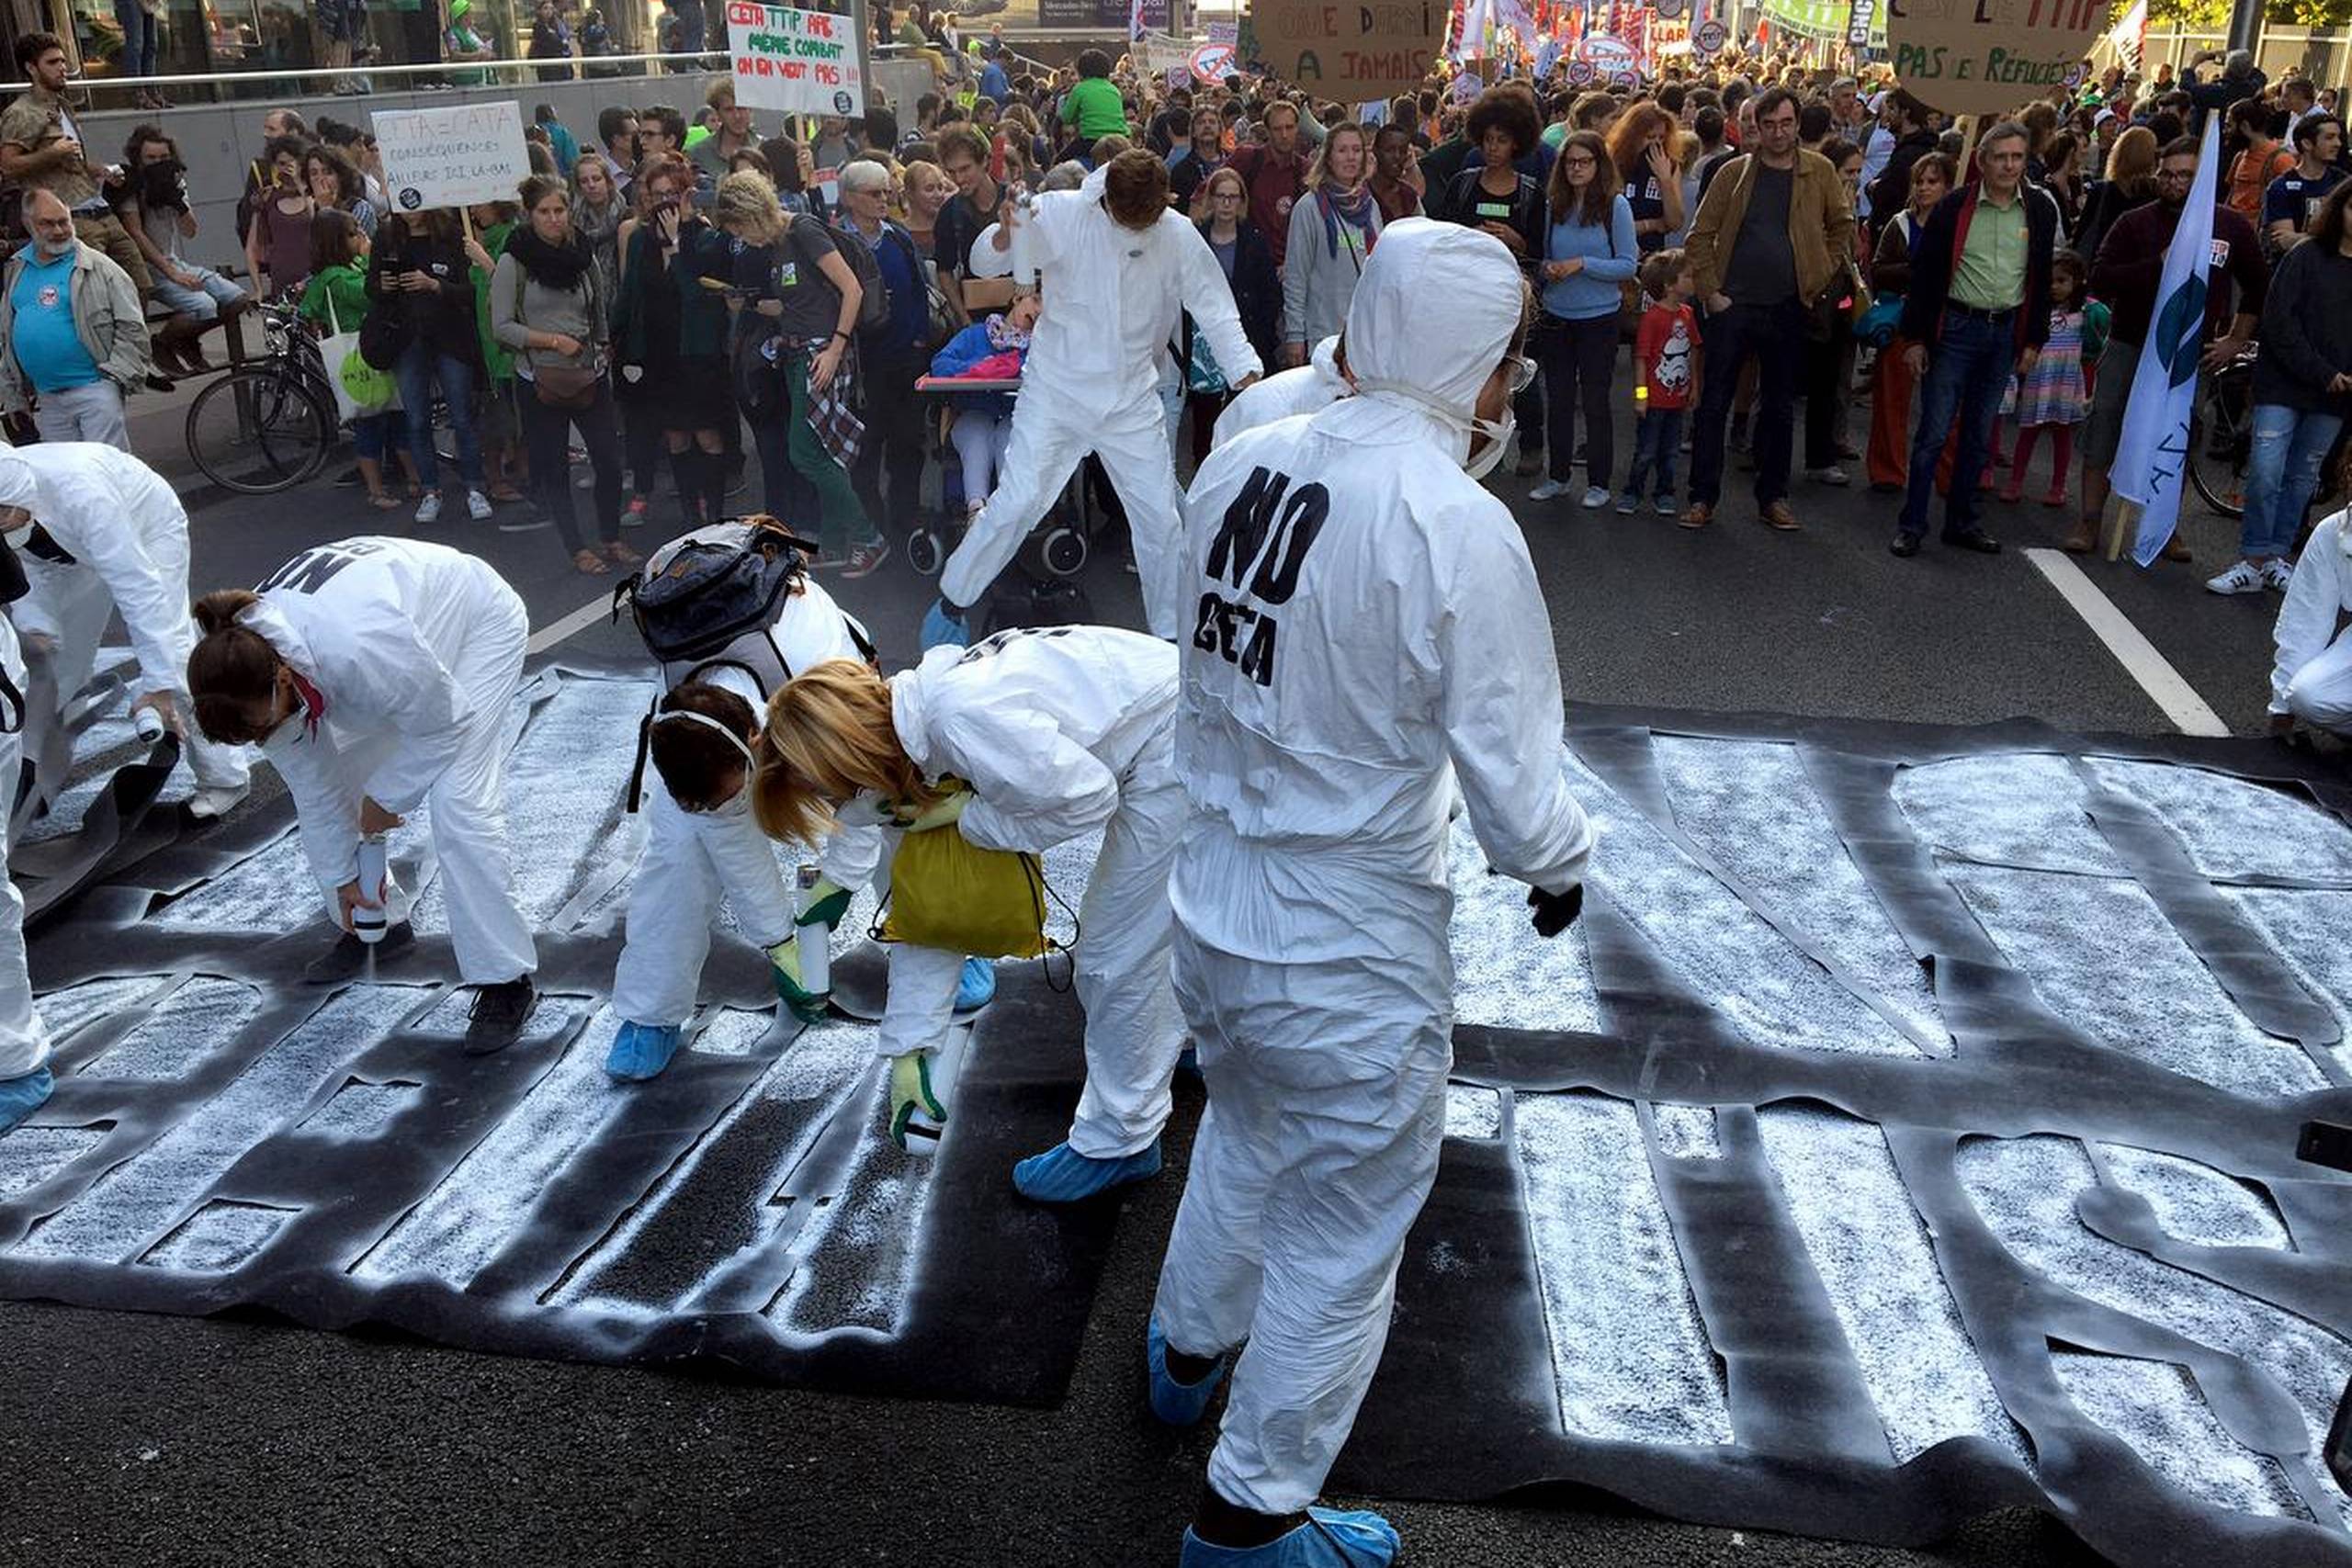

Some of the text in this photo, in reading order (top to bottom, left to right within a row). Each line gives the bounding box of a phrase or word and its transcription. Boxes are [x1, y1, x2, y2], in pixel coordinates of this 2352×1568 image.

[1296, 49, 1428, 81] A JAMAIS
[1895, 42, 1948, 80] PAS
[1205, 466, 1330, 605] NO
